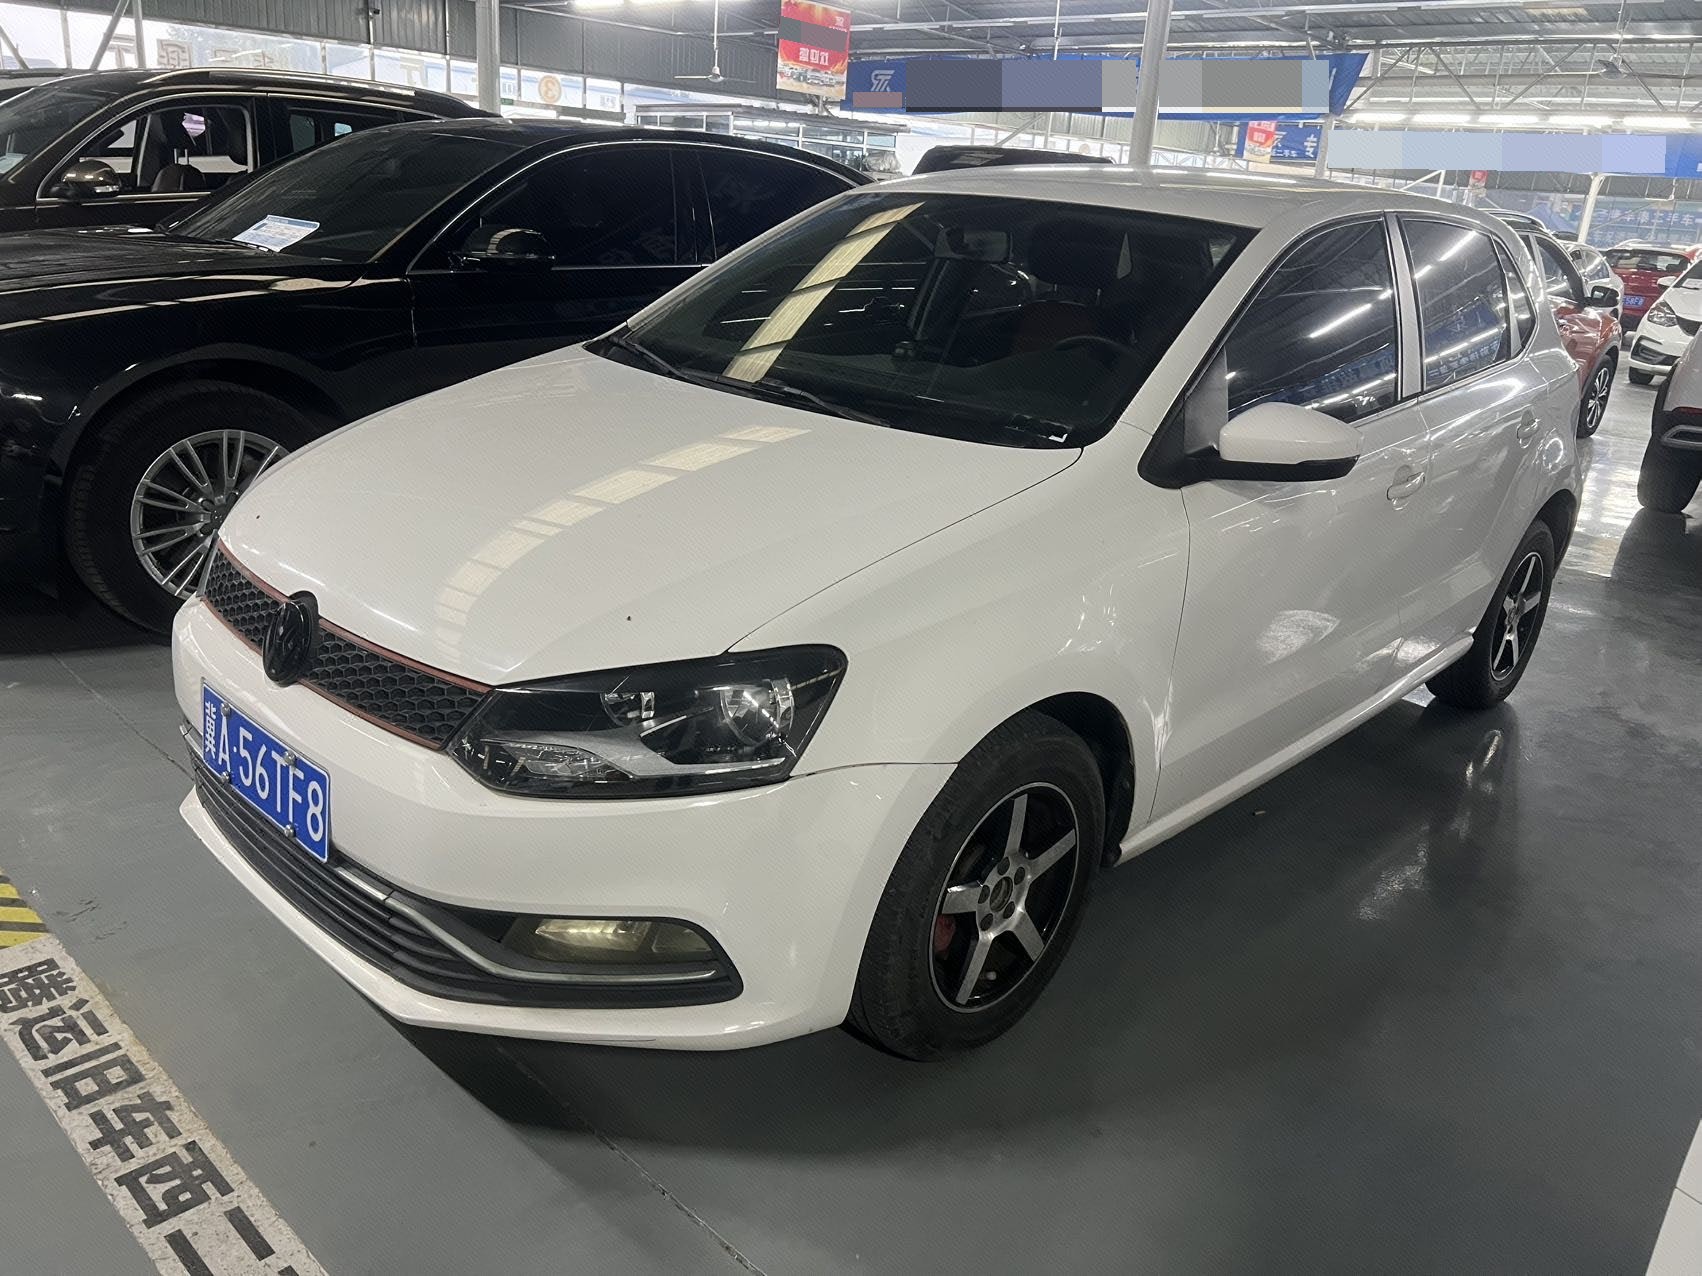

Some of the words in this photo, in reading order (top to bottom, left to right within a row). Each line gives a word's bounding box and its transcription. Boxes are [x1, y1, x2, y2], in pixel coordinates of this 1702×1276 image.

[0, 957, 299, 1276] 腾运旧车西二
